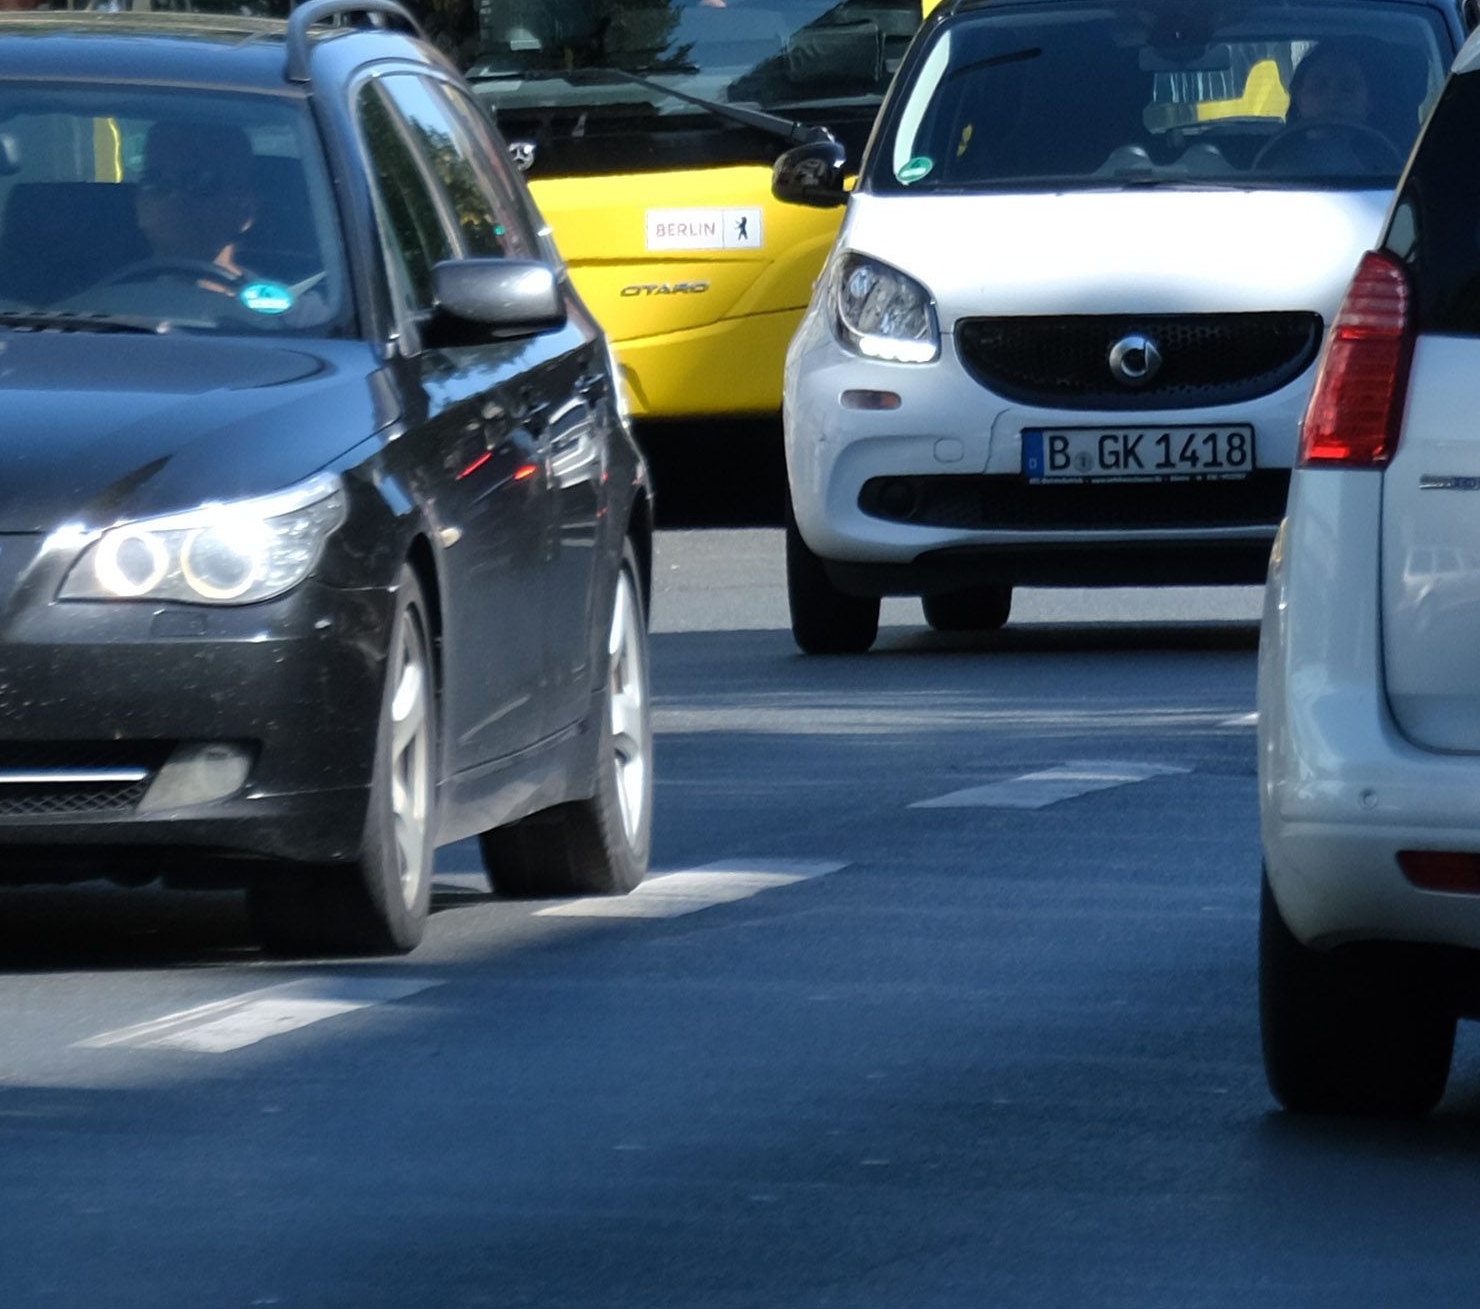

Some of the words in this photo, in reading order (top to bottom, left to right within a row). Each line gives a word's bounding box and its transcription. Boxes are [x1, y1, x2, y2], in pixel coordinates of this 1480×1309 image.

[656, 223, 715, 238] BERLIN
[620, 281, 710, 297] CITARO
[1048, 435, 1071, 471] B
[1098, 434, 1144, 469] GK
[1155, 432, 1247, 468] 1418
